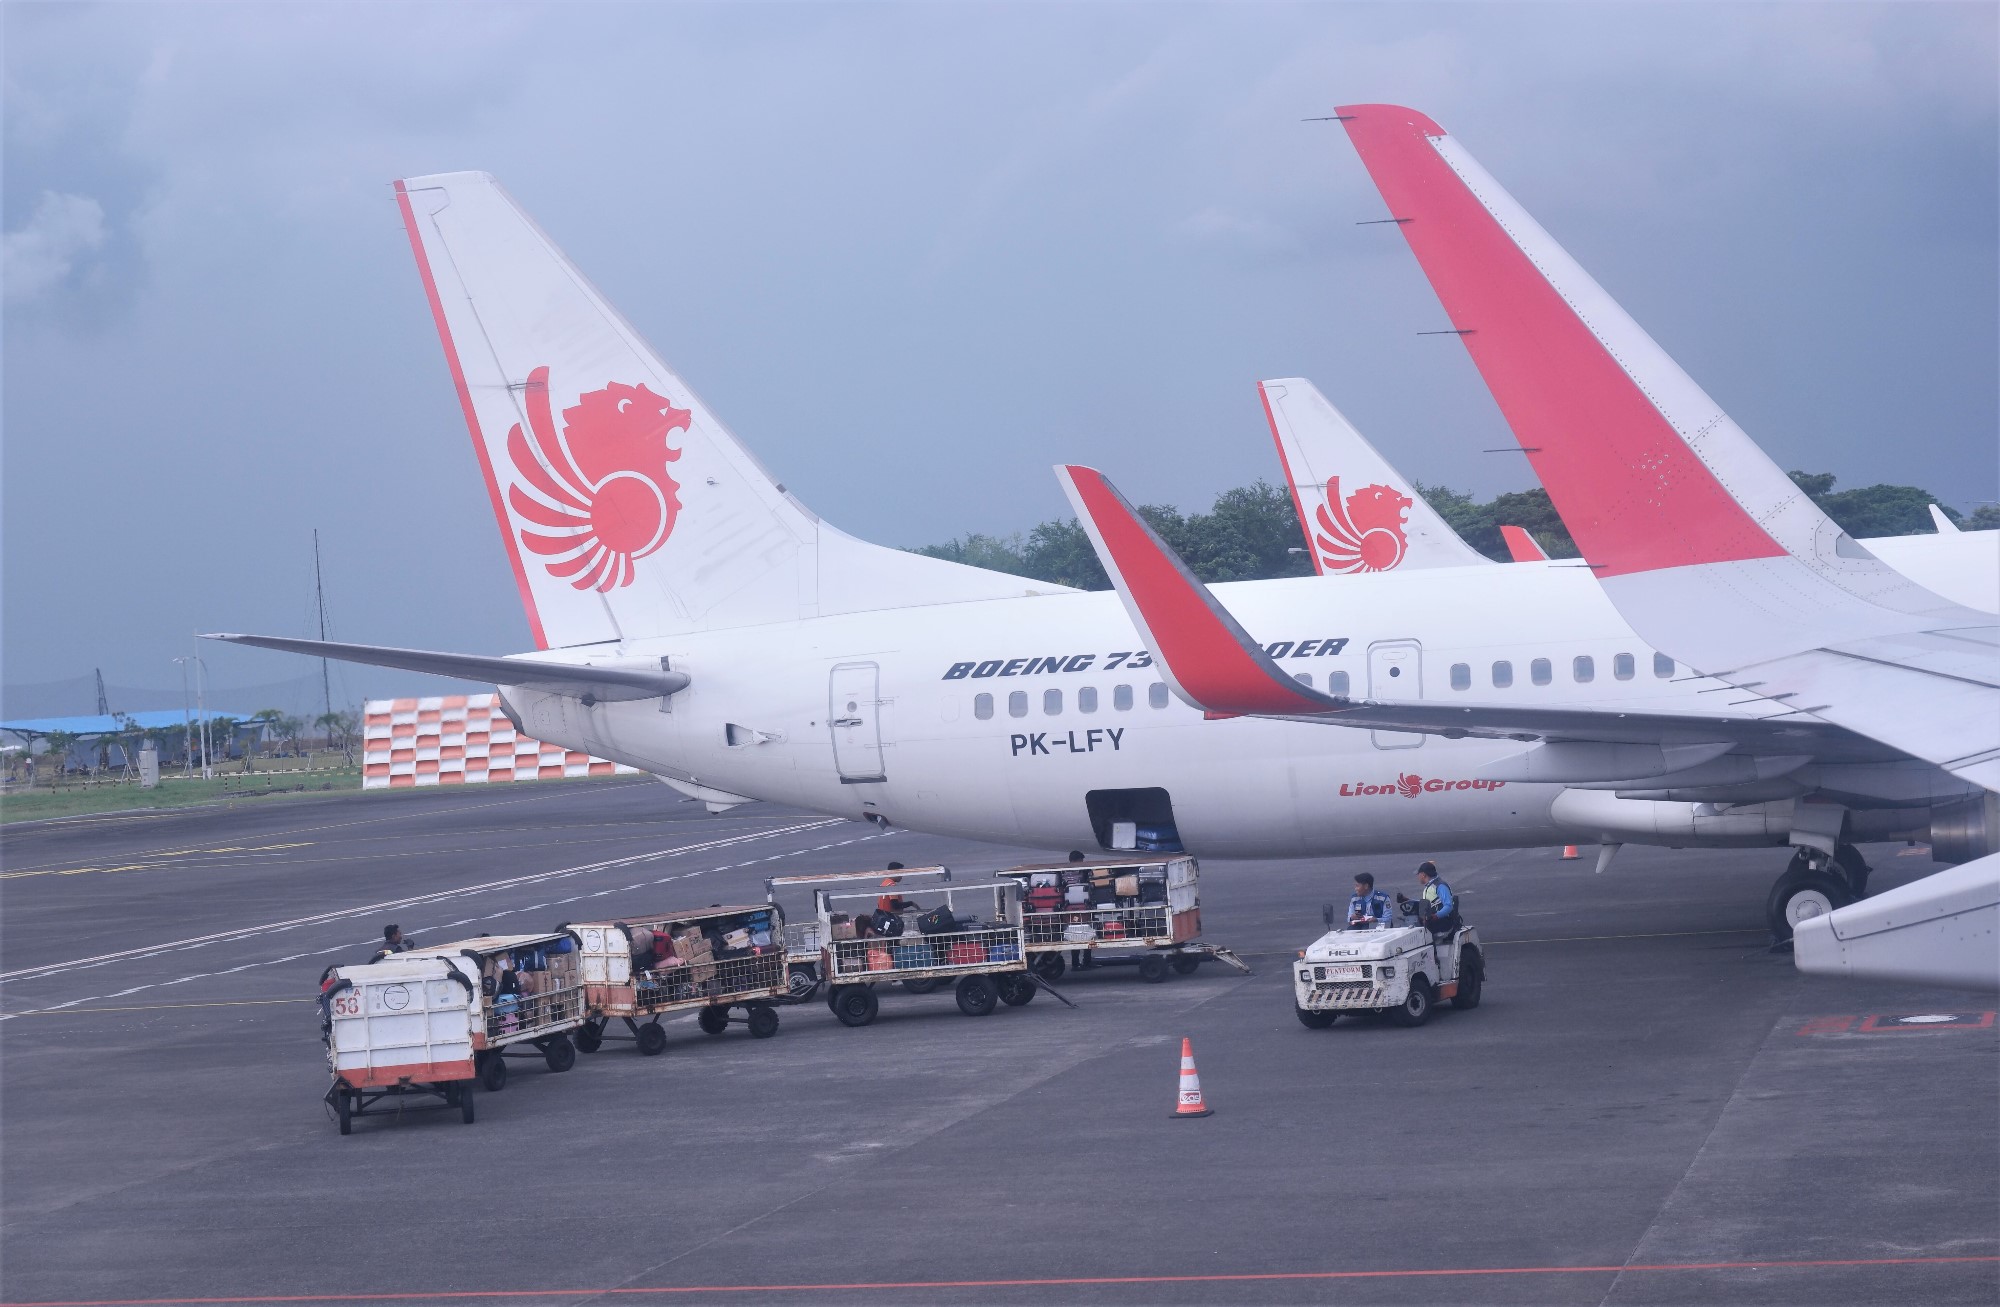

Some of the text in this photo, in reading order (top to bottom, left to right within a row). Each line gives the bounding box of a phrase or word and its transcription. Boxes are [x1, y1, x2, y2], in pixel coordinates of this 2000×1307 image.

[941, 654, 1096, 680] BOEING
[1010, 727, 1124, 757] PK-LFY
[1339, 778, 1506, 797] Lion Group
